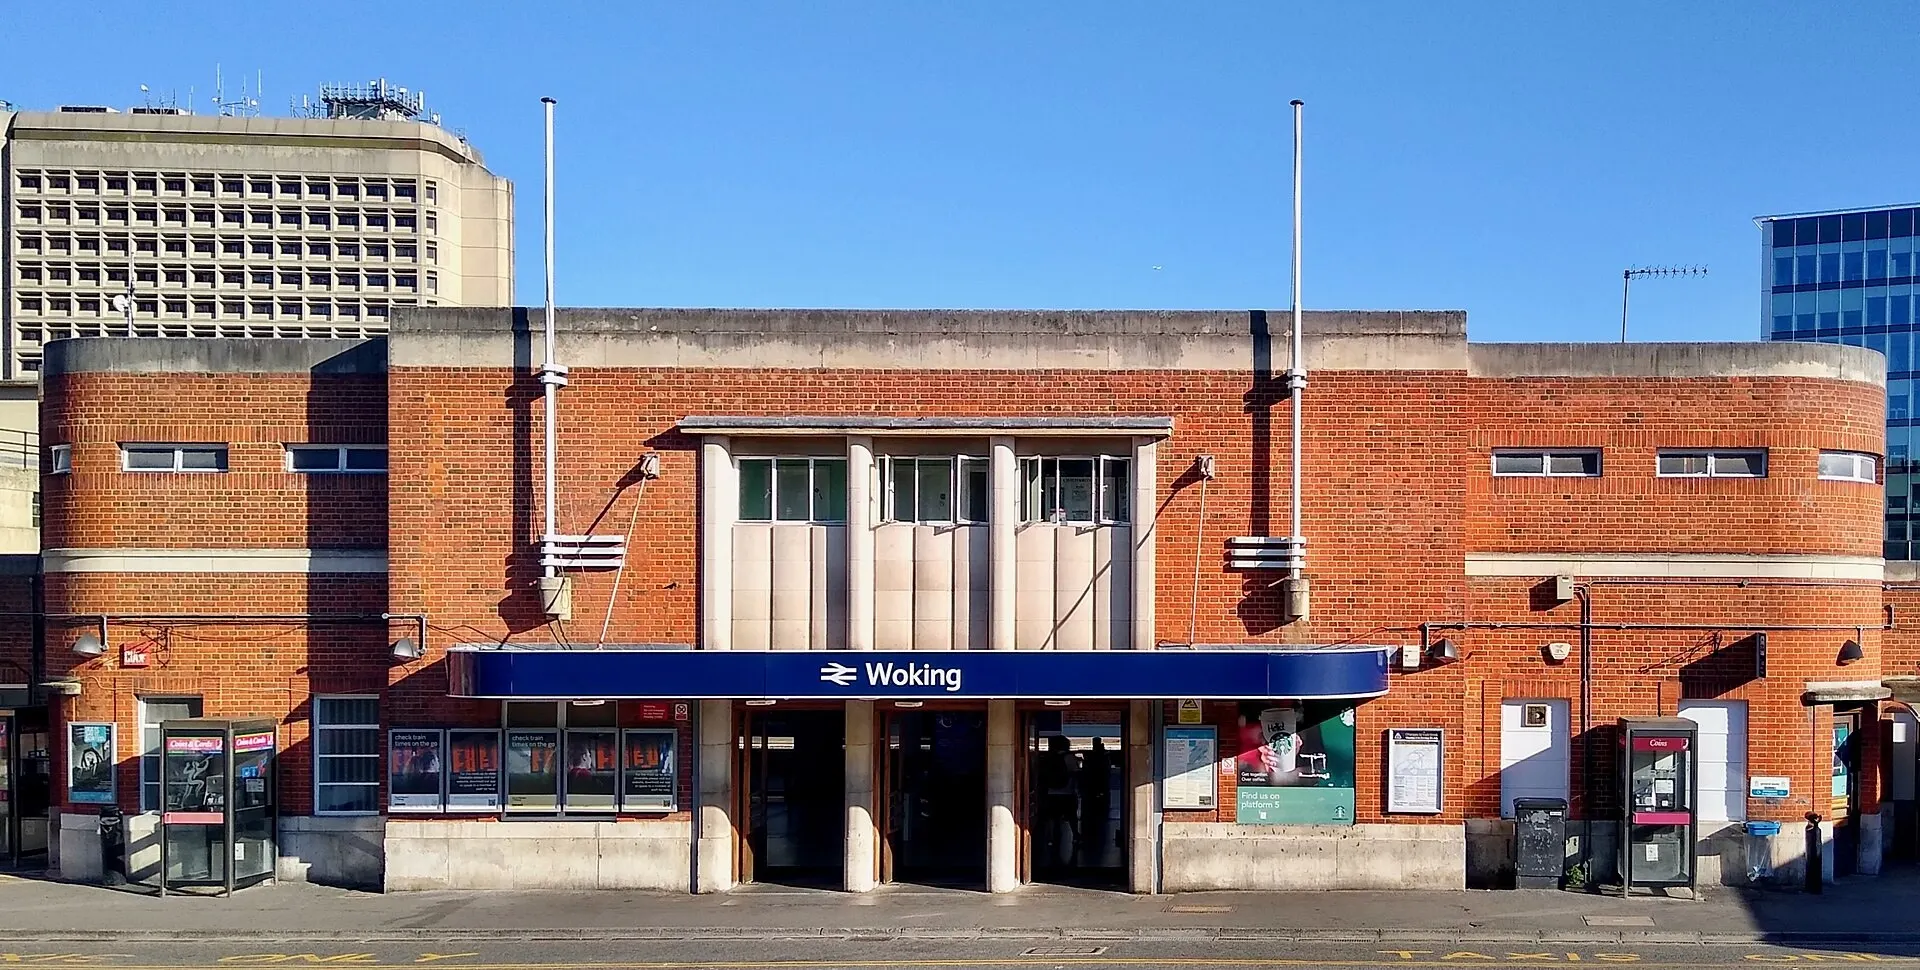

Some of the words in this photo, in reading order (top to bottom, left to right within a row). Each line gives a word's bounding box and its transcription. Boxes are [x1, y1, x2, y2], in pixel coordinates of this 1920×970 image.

[865, 662, 962, 691] Woking
[1649, 739, 1668, 747] Coins
[1241, 791, 1258, 800] Find
[1241, 800, 1273, 810] platform
[1274, 800, 1280, 808] 5
[1376, 950, 1641, 962] TAXIS
